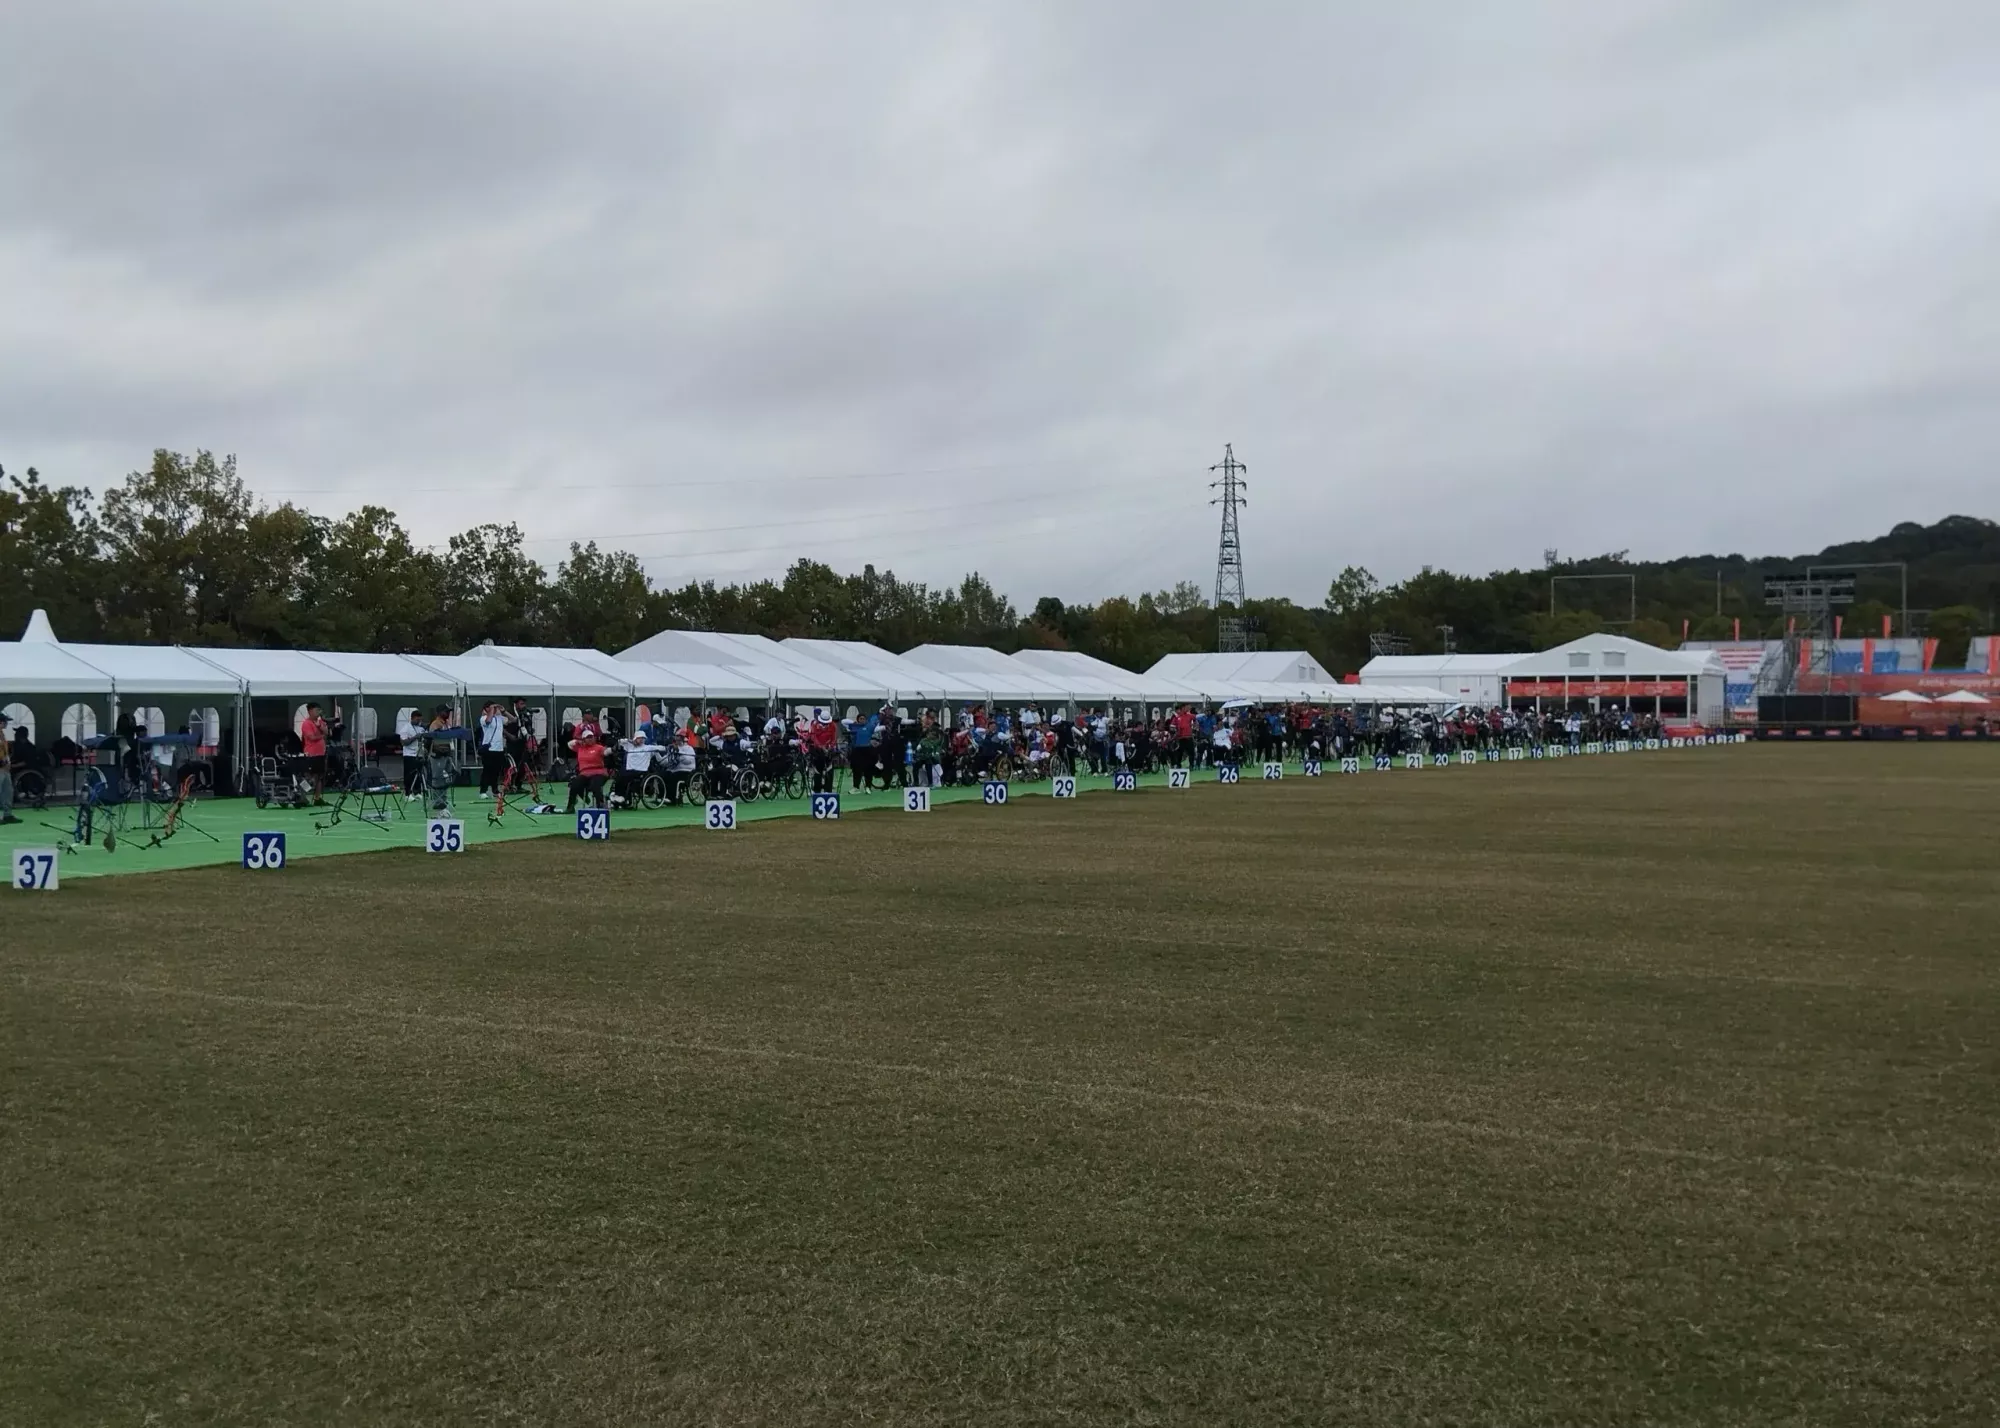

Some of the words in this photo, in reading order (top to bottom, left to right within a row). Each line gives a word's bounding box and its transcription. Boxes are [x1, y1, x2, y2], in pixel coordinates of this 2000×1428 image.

[1552, 746, 1562, 757] 15
[1570, 745, 1580, 755] 14
[1589, 744, 1598, 753] 13
[1605, 743, 1614, 753] 12
[1618, 742, 1627, 751] 11
[1633, 741, 1643, 750] 10
[1463, 752, 1474, 763] 19
[1487, 751, 1499, 761] 18
[1511, 749, 1521, 759] 17
[1532, 748, 1543, 758] 16
[1344, 760, 1358, 773] 23
[1376, 758, 1391, 770] 22
[1410, 757, 1420, 768] 21
[1435, 754, 1448, 766] 20
[1221, 768, 1238, 783] 26
[1265, 765, 1281, 778] 25
[1306, 763, 1321, 776] 24
[1116, 775, 1134, 790] 28
[1171, 772, 1188, 787] 27
[985, 785, 1007, 804] 30
[1055, 779, 1073, 797] 29
[908, 791, 928, 810] 31
[815, 798, 838, 819] 32
[709, 805, 733, 827] 33
[580, 813, 608, 839] 34
[430, 823, 460, 851] 35
[247, 838, 282, 868] 36
[19, 855, 53, 888] 37
